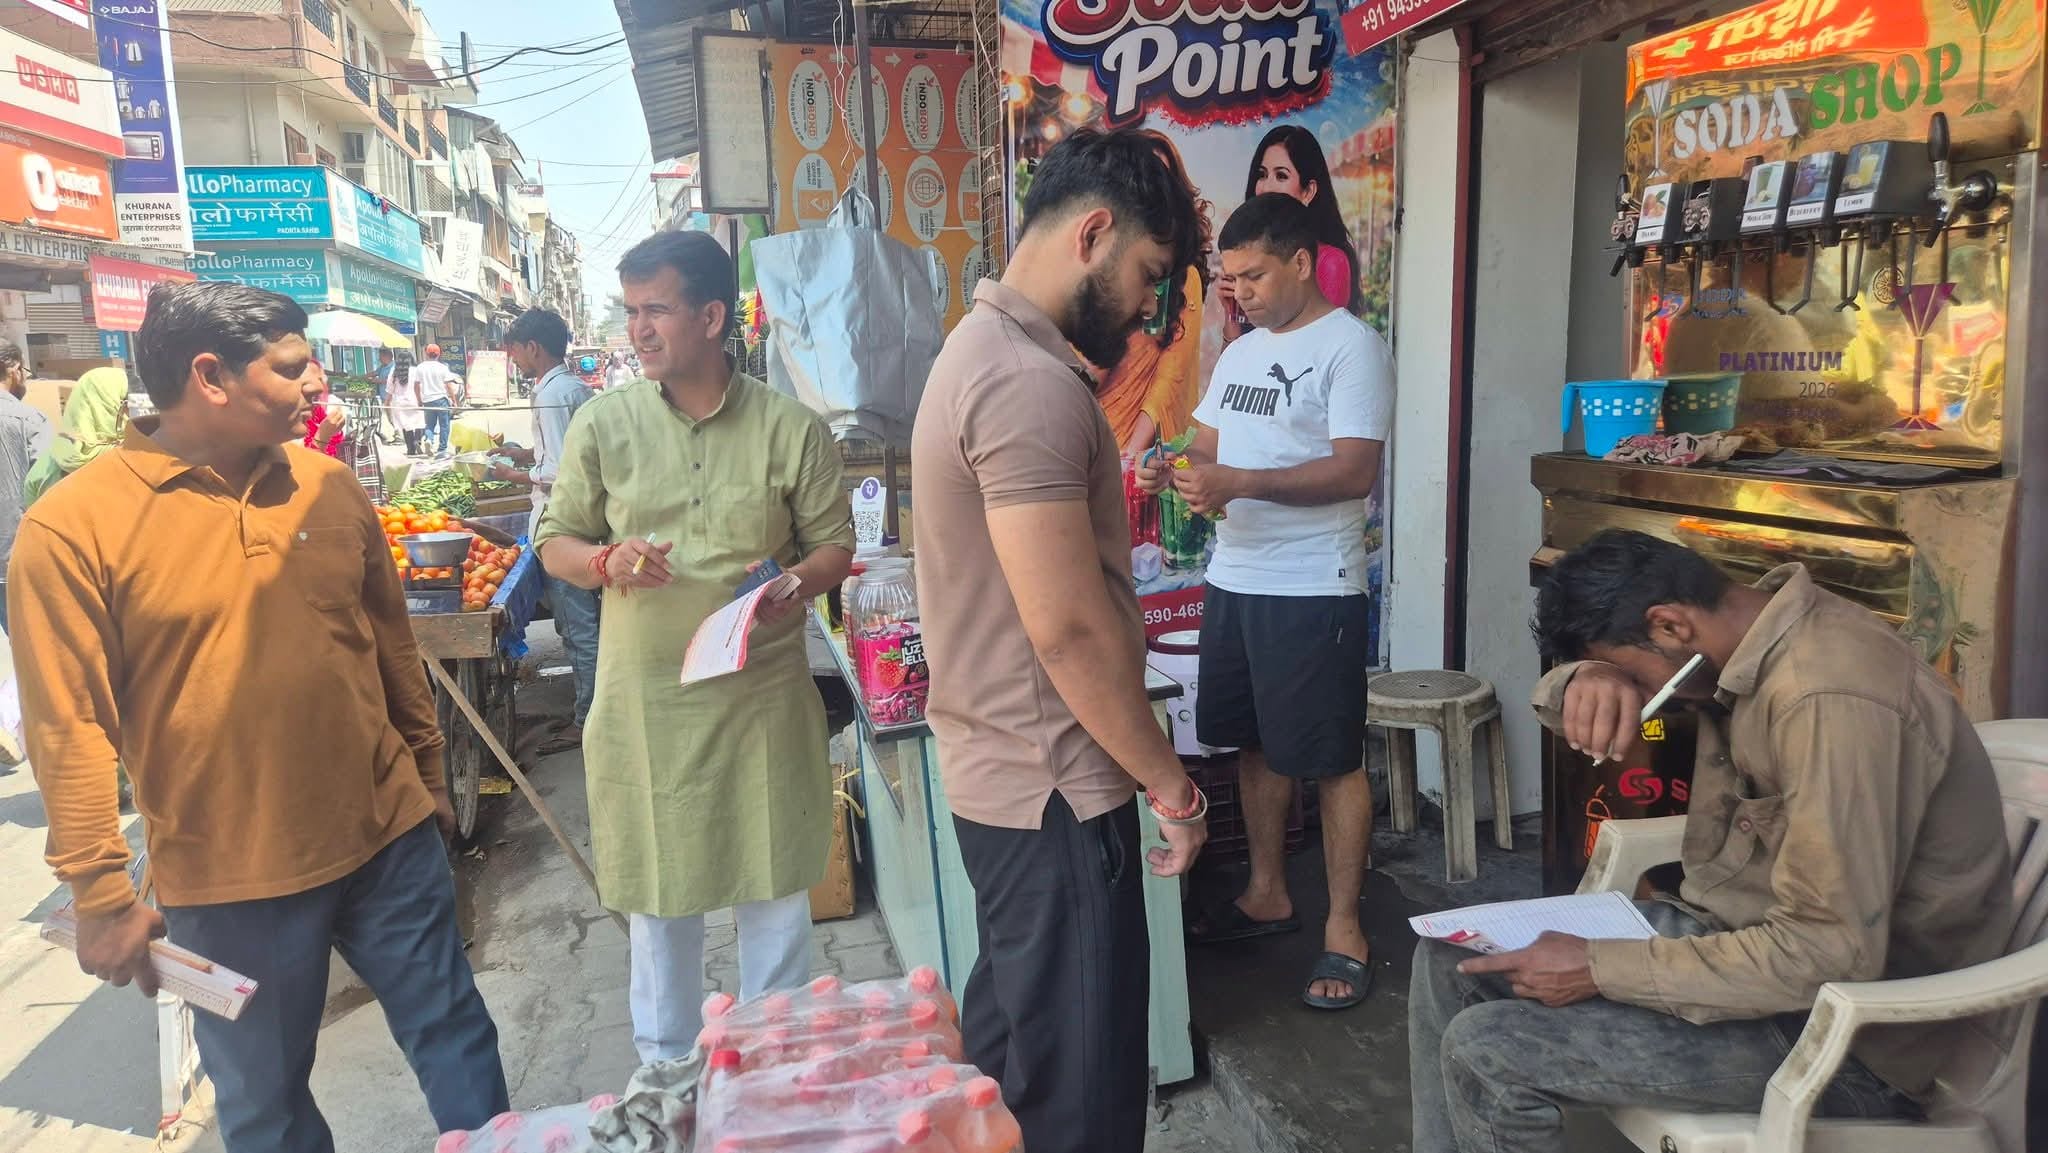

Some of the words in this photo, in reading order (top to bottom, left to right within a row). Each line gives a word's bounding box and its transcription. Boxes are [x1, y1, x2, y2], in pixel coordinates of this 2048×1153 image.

[111, 6, 154, 14] BAJAJ
[1362, 4, 1385, 31] +91
[18, 57, 78, 101] USHA
[1101, 15, 1323, 116] Point
[806, 78, 818, 138] INDOBOND
[919, 82, 928, 142] INDOBOND
[1673, 87, 1798, 159] SODA
[1810, 43, 1963, 130] SHOP
[120, 213, 181, 221] ENTERPRISES
[125, 202, 172, 210] KHURANA
[96, 273, 141, 300] KHURANA
[1719, 351, 1843, 372] PLATINIUM
[1218, 383, 1280, 416] PUMA
[1800, 382, 1837, 399] 2026
